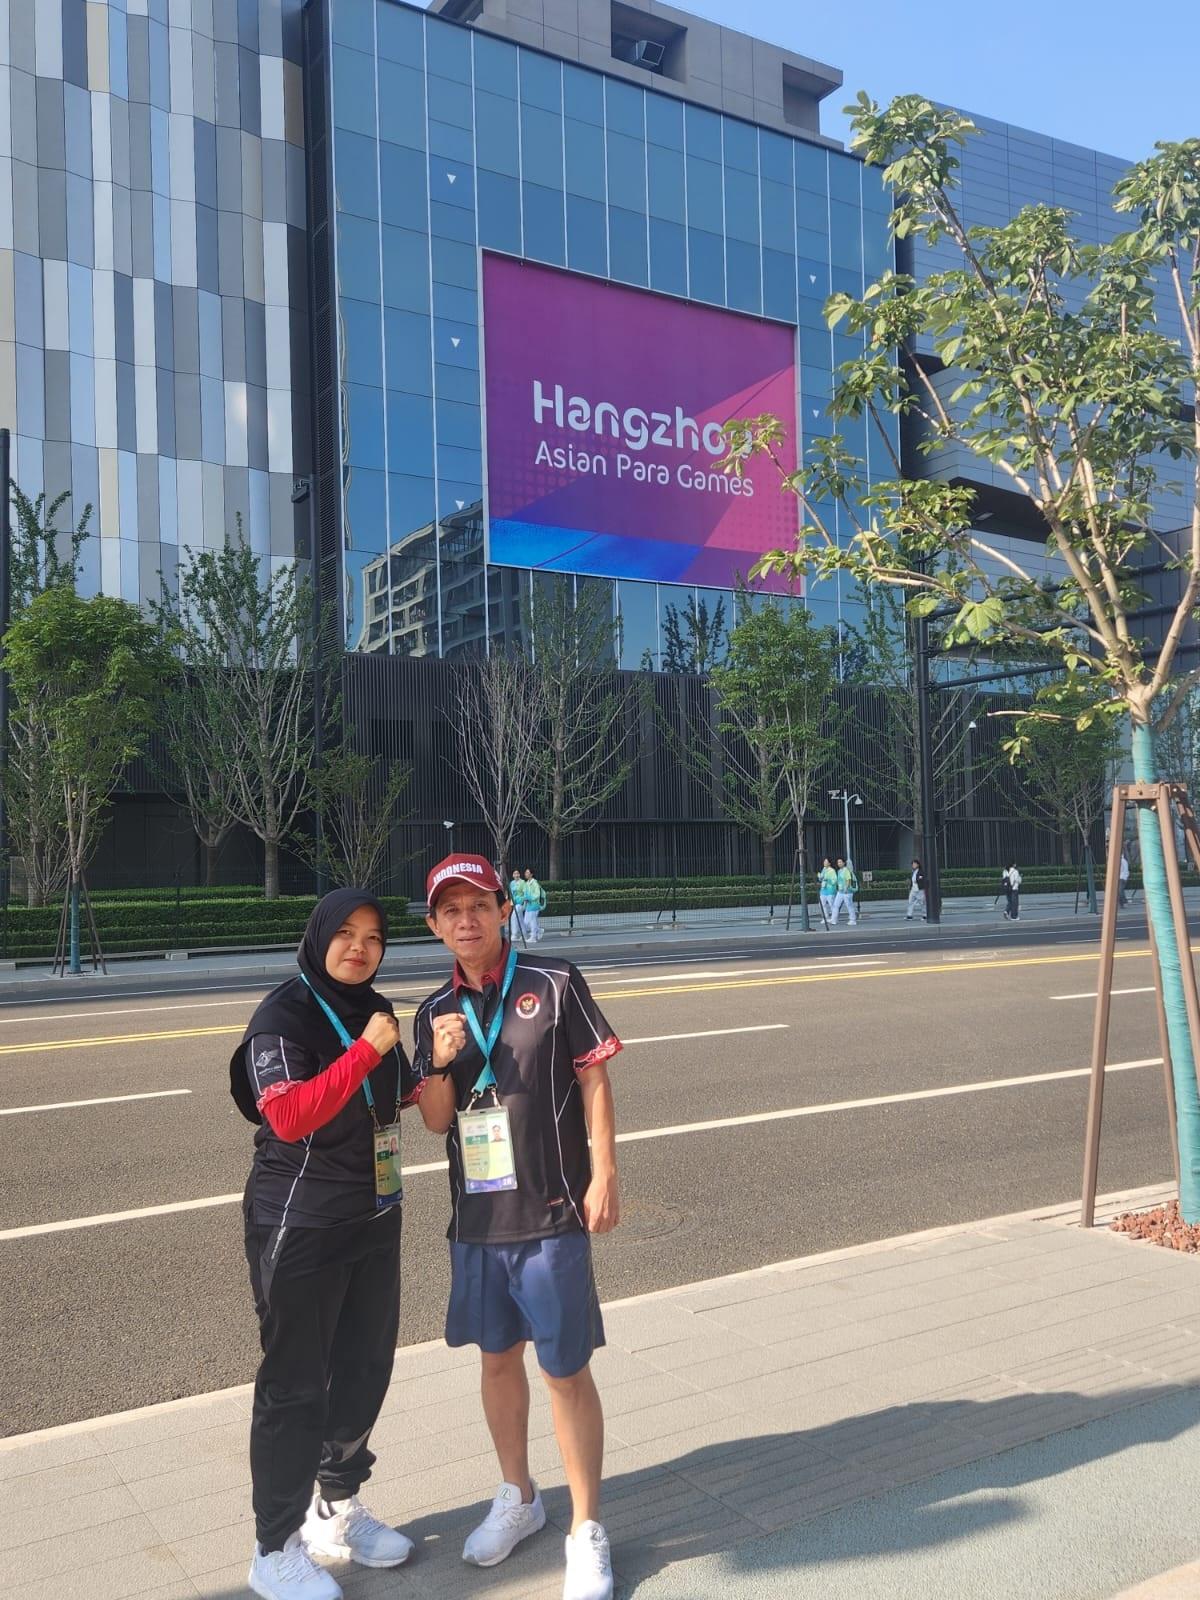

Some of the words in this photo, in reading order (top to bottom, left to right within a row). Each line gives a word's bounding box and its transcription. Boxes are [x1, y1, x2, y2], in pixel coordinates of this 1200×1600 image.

[535, 440, 607, 475] Asian
[617, 453, 670, 485] Para
[677, 464, 754, 497] Games
[433, 862, 484, 884] INDONESIA
